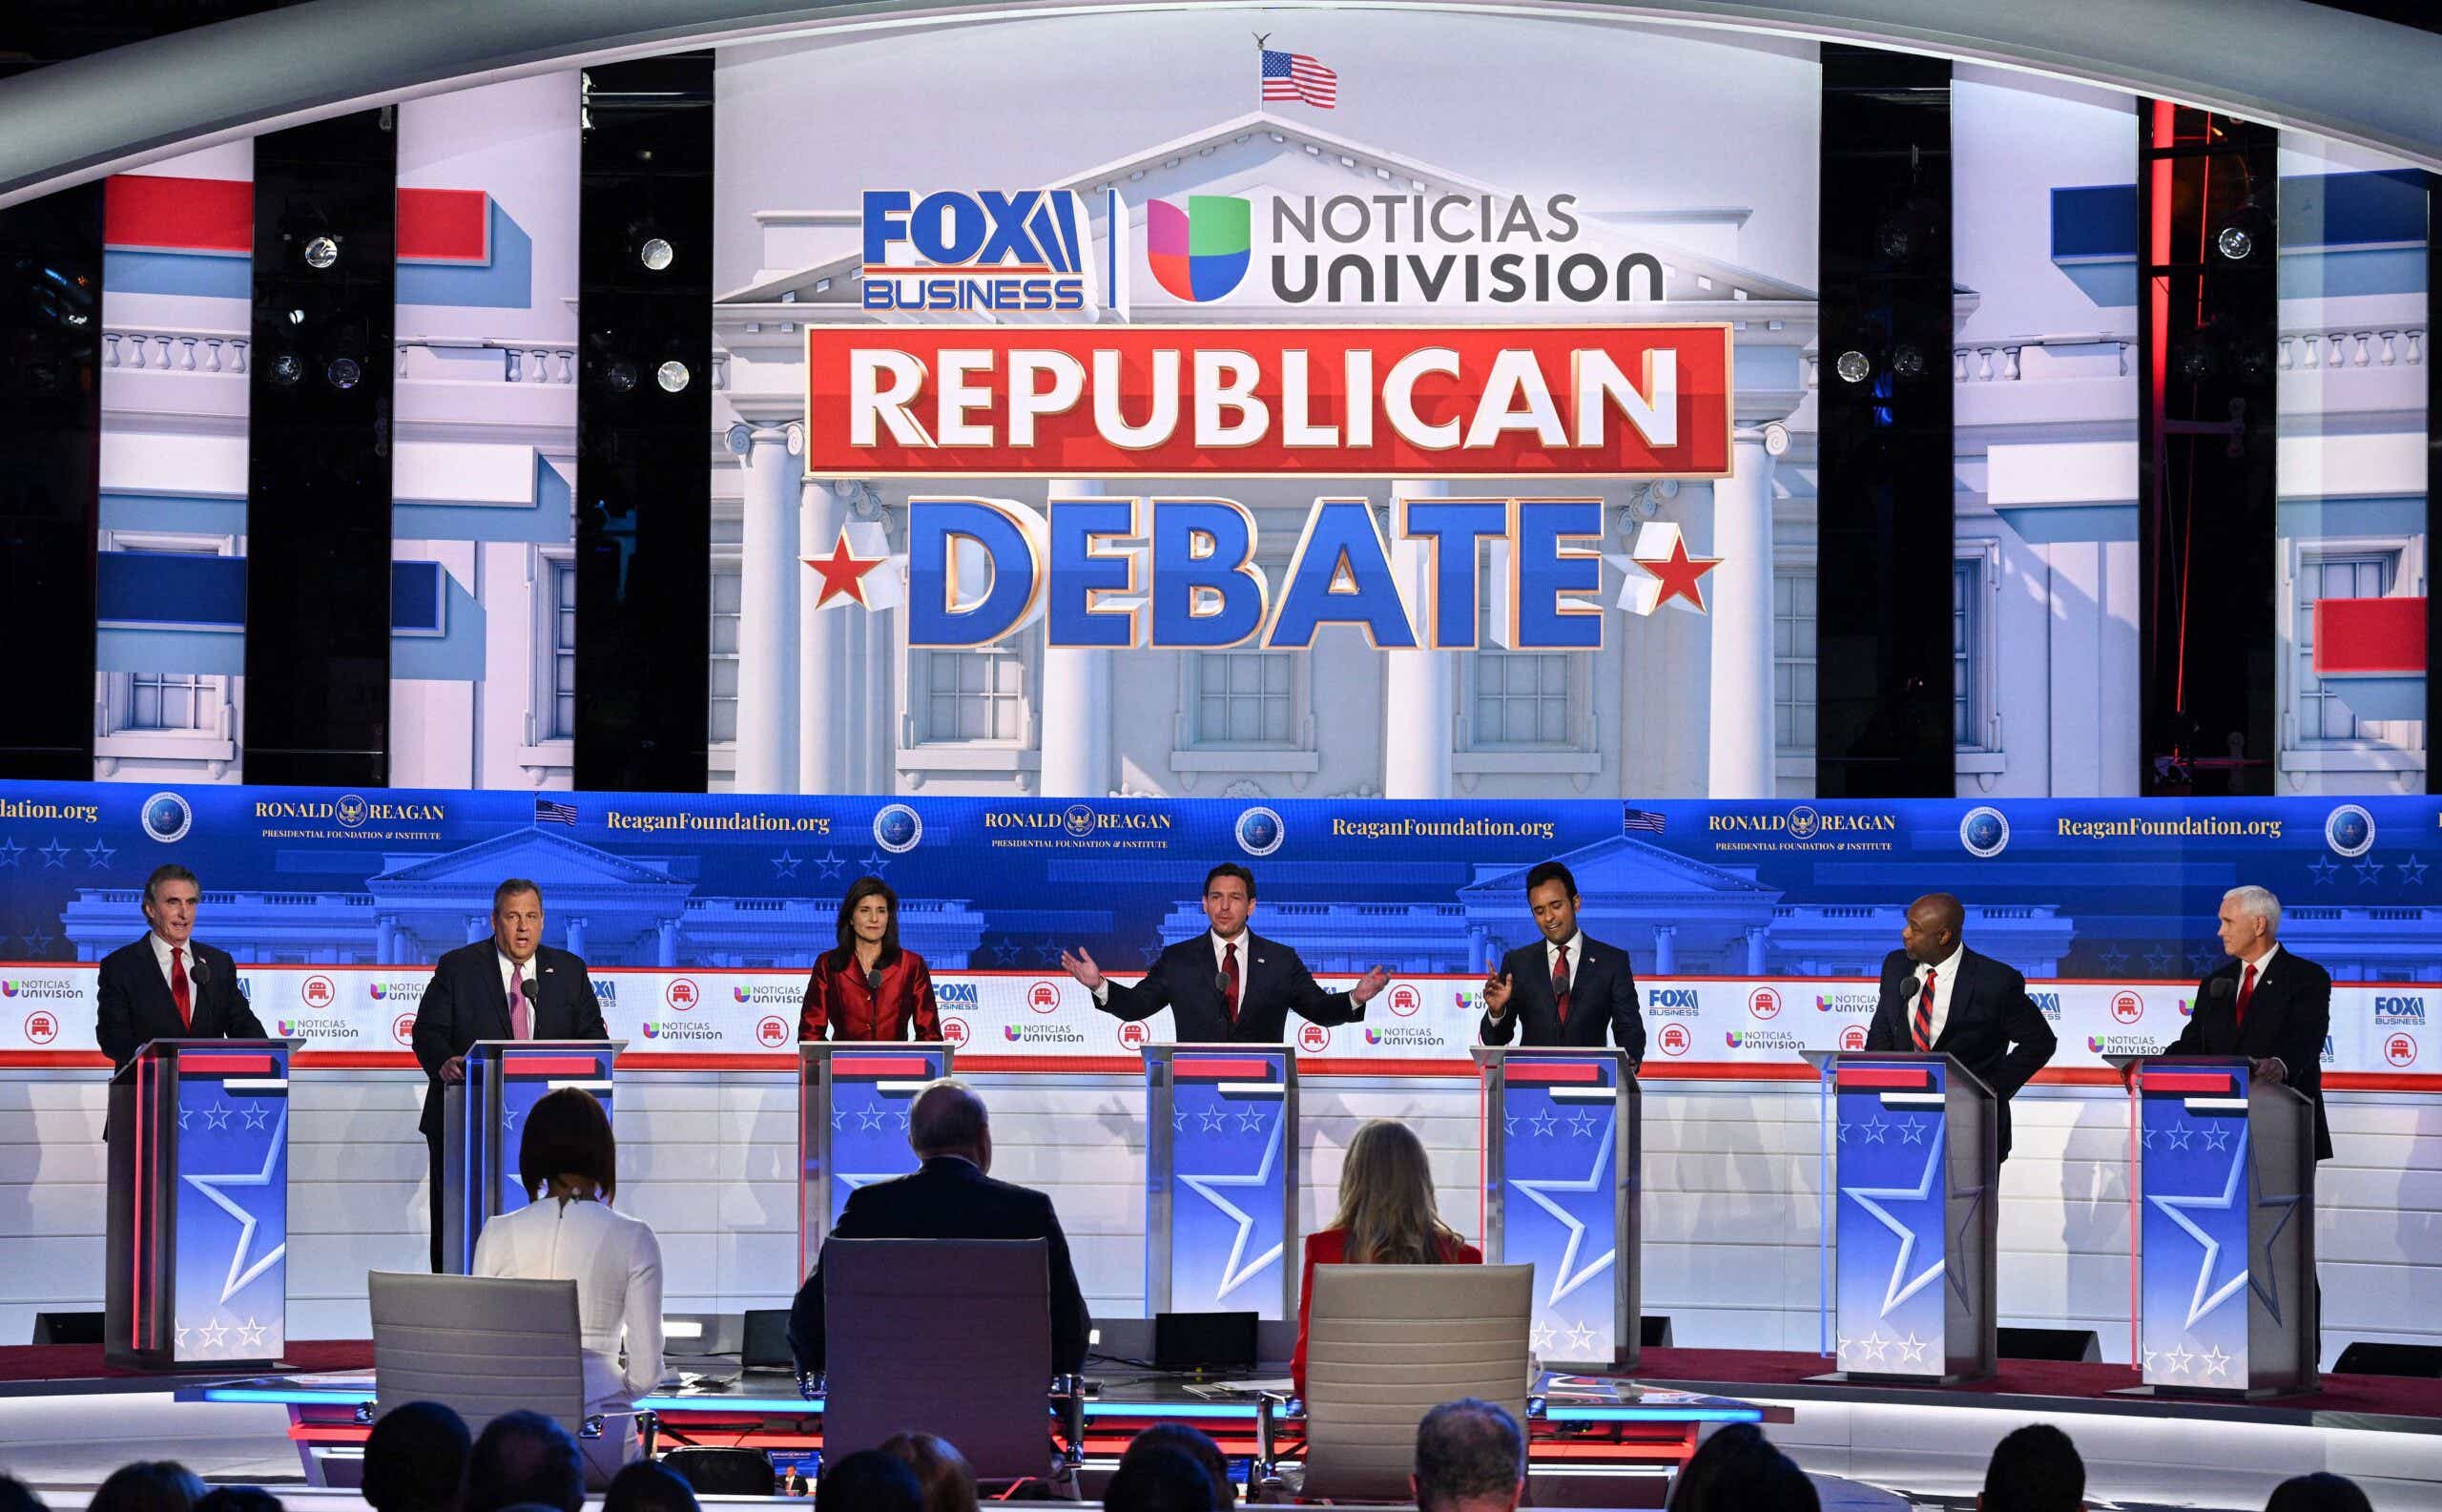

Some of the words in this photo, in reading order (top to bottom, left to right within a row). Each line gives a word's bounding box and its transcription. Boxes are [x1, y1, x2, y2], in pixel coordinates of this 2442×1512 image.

[1273, 194, 1580, 245] NOTICIAS
[862, 190, 1082, 273] FOX
[862, 280, 1084, 310] BUSINESS
[849, 347, 1677, 450] REPUBLICAN
[906, 496, 1604, 650] DEBATE
[256, 802, 333, 818] RONALD
[369, 804, 445, 820] REAGAN
[607, 811, 831, 836] ReaganFoundation.org
[984, 813, 1063, 829] RONALD
[1097, 814, 1171, 830] REAGAN
[1708, 815, 1786, 831] RONALD
[1821, 815, 1896, 831] REAGAN
[1332, 818, 1555, 839] ReaganFoundation.org
[2057, 817, 2282, 839] ReaganFoundation.org
[262, 829, 325, 839] PRESIDENTIAL
[327, 830, 383, 839] FOUNDATION
[395, 832, 442, 840] INSTITUTE
[991, 839, 1054, 848] PRESIDENTIAL
[1056, 839, 1111, 848] FOUNDATION
[1123, 840, 1169, 849] INSTITUTE
[1715, 841, 1777, 851] PRESIDENTIAL
[1779, 841, 1835, 851] FOUNDATION
[1847, 841, 1893, 851] INSTITUTE
[21, 980, 71, 989] NOTICIAS
[390, 983, 424, 992] NOTICI
[754, 985, 801, 995] NOTICIAS
[390, 992, 423, 1001] UNIVI
[754, 995, 804, 1004] UNIVISIO
[1649, 989, 1699, 1008] FOX
[1835, 995, 1880, 1004] NOTICIA
[1835, 1004, 1875, 1013] UNIVIS
[2375, 996, 2426, 1018] FOX
[298, 1019, 346, 1028] NOTICIAS
[662, 1022, 710, 1031] NOTICIAS
[1024, 1025, 1071, 1034] NOTICIAS
[1384, 1027, 1432, 1037] NOTICIAS
[1745, 1031, 1792, 1041] NOTICIAS
[2107, 1036, 2155, 1045] NOTICIAS
